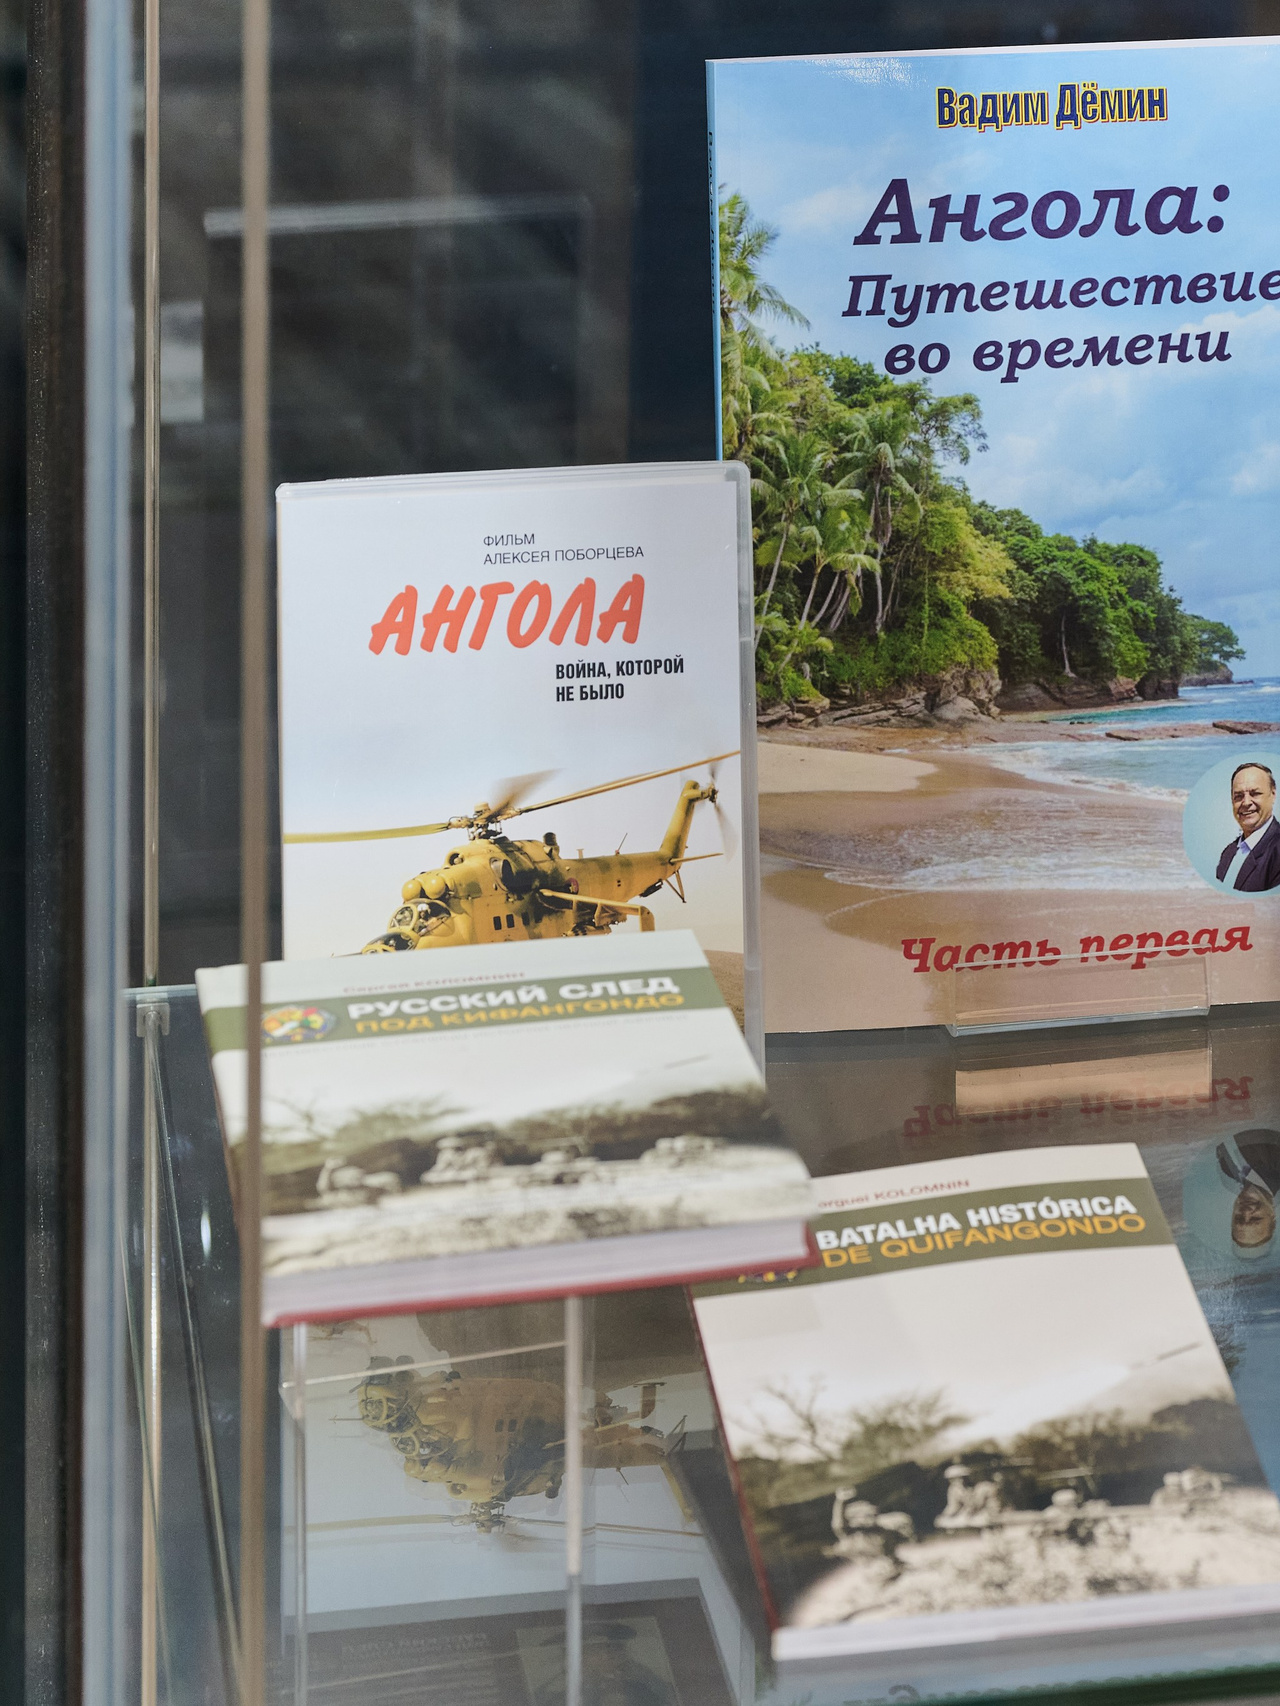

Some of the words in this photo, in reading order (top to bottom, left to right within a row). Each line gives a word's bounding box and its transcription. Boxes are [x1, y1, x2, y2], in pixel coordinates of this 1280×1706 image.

[936, 85, 1049, 133] Вадим
[1054, 82, 1169, 131] Дёмин
[853, 178, 1230, 245] Ангола:
[884, 338, 950, 376] во
[973, 331, 1232, 383] времени
[482, 533, 536, 547] ФИЛЬМ
[483, 550, 551, 566] АЛЕКСЕЯ
[554, 546, 645, 563] ПОБОРЦЕВА
[368, 573, 646, 656] АНГОЛА
[555, 660, 612, 680] ВОЙНА,
[615, 654, 685, 677] КОТОРОЙ
[555, 686, 575, 702] НЕ
[579, 683, 625, 701] БЫЛО
[901, 936, 1062, 973] Часть
[1079, 926, 1253, 970] первая
[347, 983, 550, 1020] РУССКИЙ
[558, 976, 682, 1000] СЛЕД
[355, 1014, 435, 1035] ПОД
[440, 993, 686, 1027] КИФАНГОНДО
[873, 1179, 970, 1200] KOLOMNIN
[815, 1212, 963, 1251] BATALHA
[966, 1195, 1138, 1228] HISTÓRICA
[822, 1243, 873, 1269] DE
[880, 1213, 1147, 1259] QUIFANGONDO
